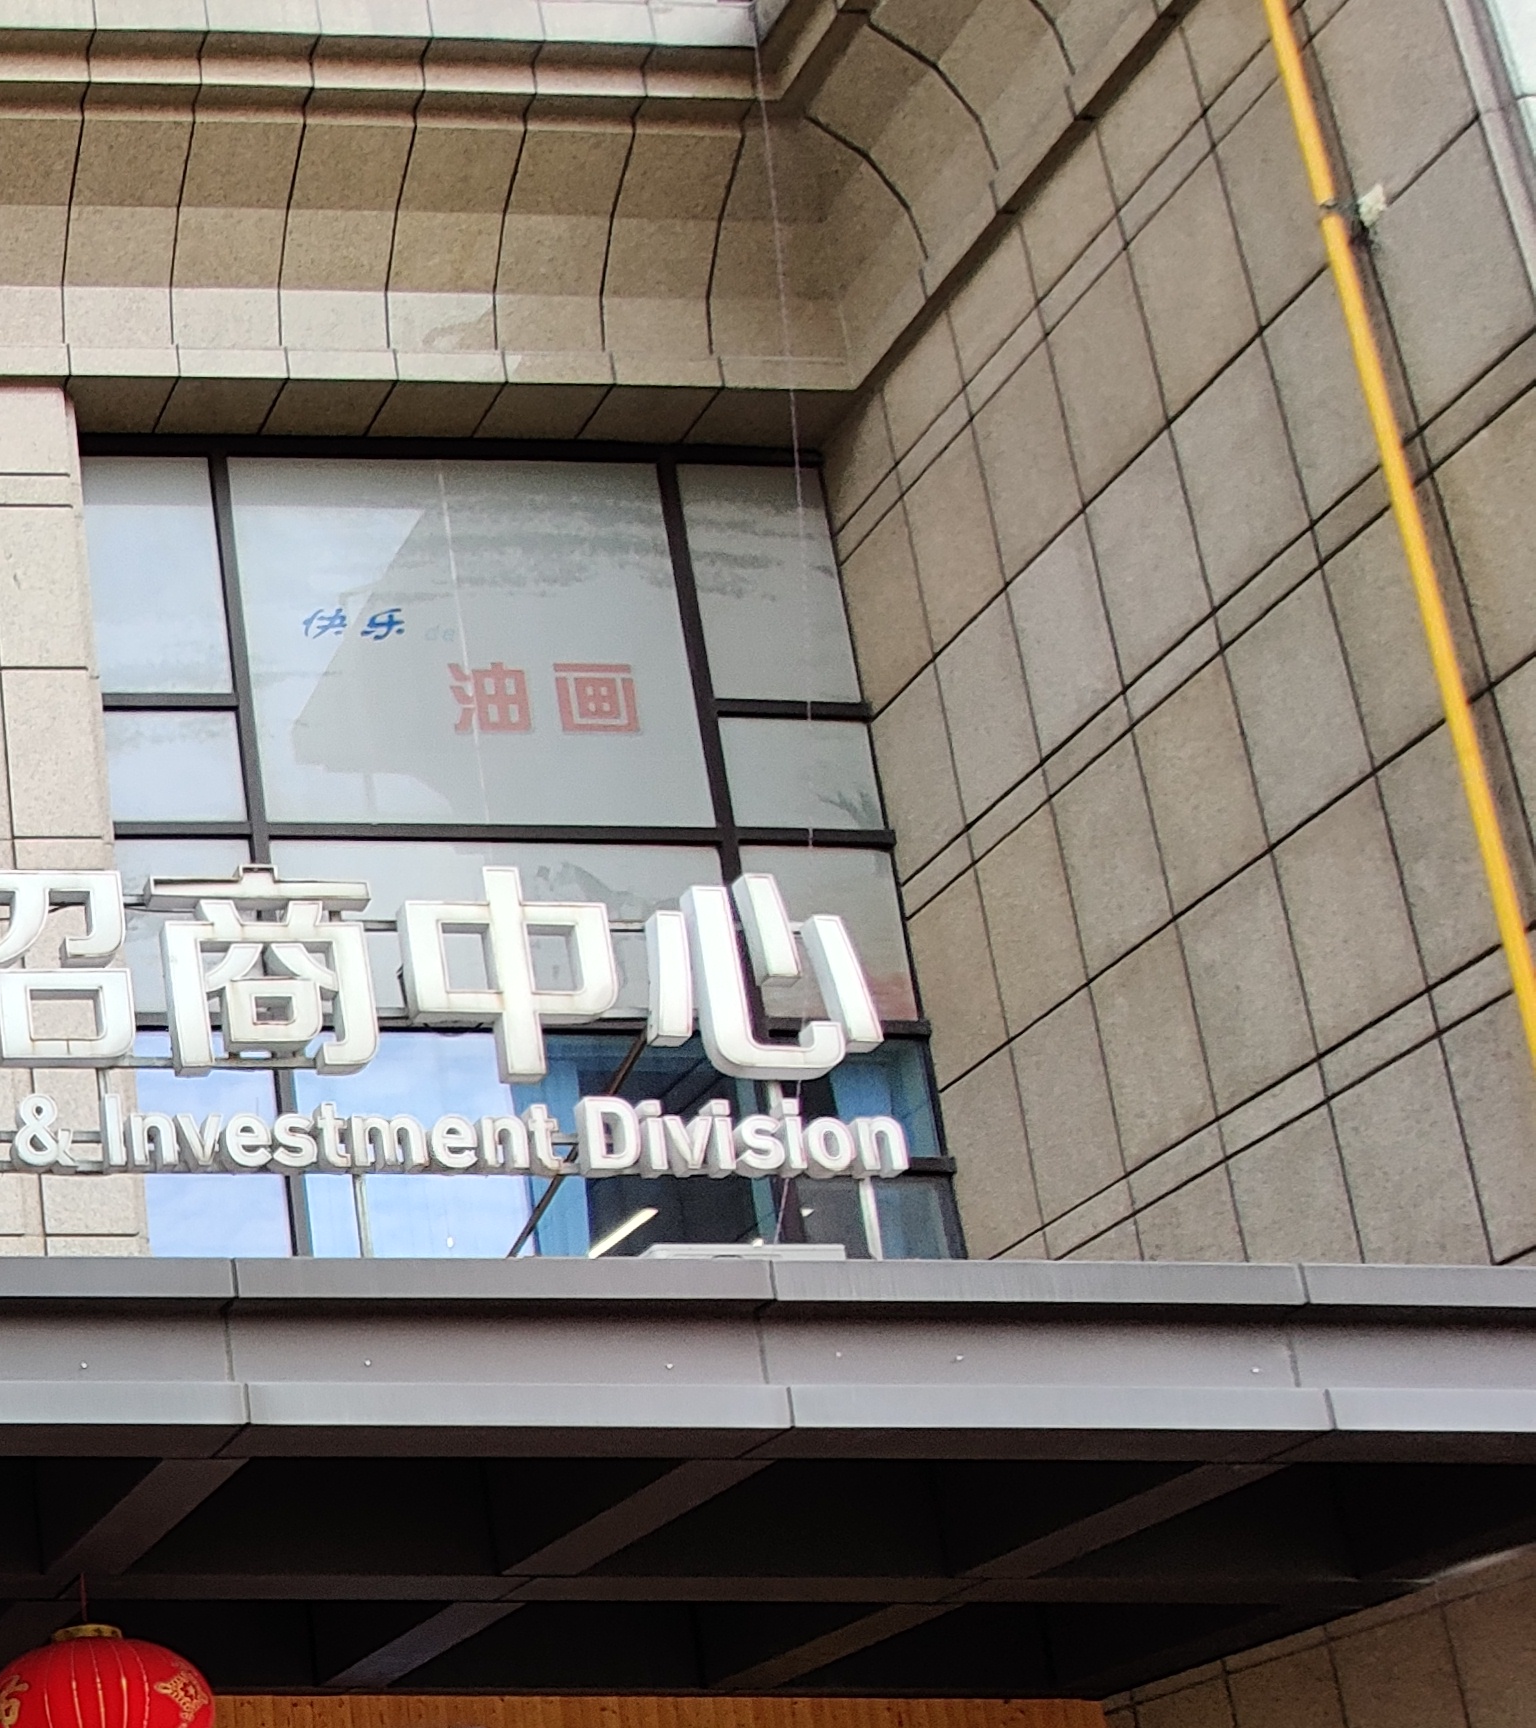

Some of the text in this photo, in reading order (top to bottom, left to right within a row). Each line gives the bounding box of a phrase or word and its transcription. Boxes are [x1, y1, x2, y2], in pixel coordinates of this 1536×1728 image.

[447, 661, 642, 735] 油画
[12, 1092, 79, 1169] &
[100, 1092, 568, 1176] Investment
[574, 1095, 911, 1179] Division
